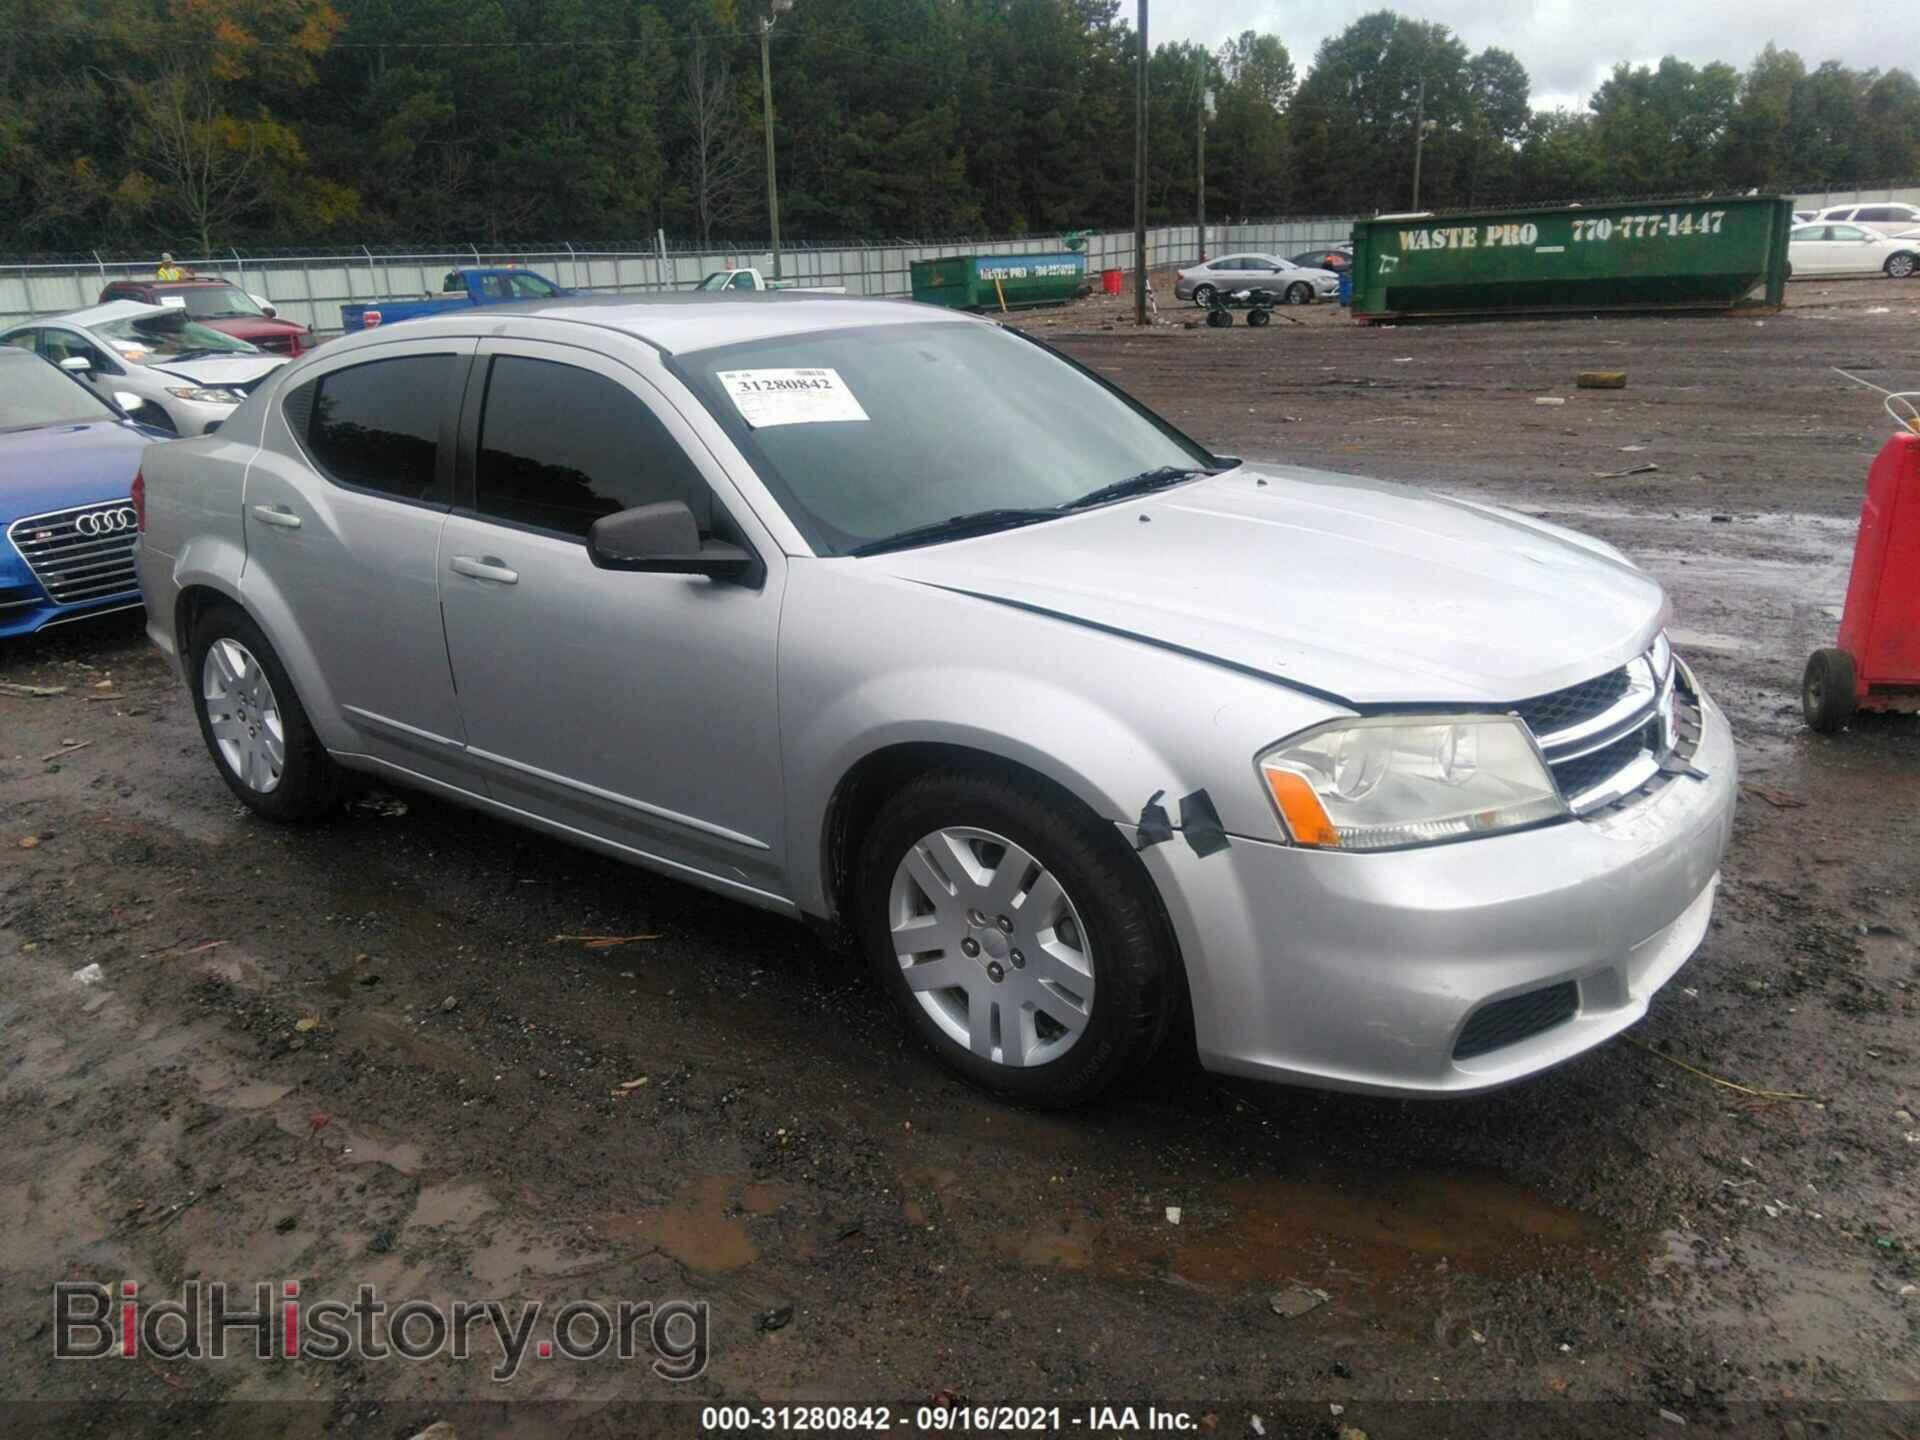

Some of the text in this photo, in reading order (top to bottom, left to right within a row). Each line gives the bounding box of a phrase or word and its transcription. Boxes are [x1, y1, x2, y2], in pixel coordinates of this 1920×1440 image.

[1399, 210, 1726, 251] WASTE PRO 770-777-1447
[738, 378, 832, 392] 31280842
